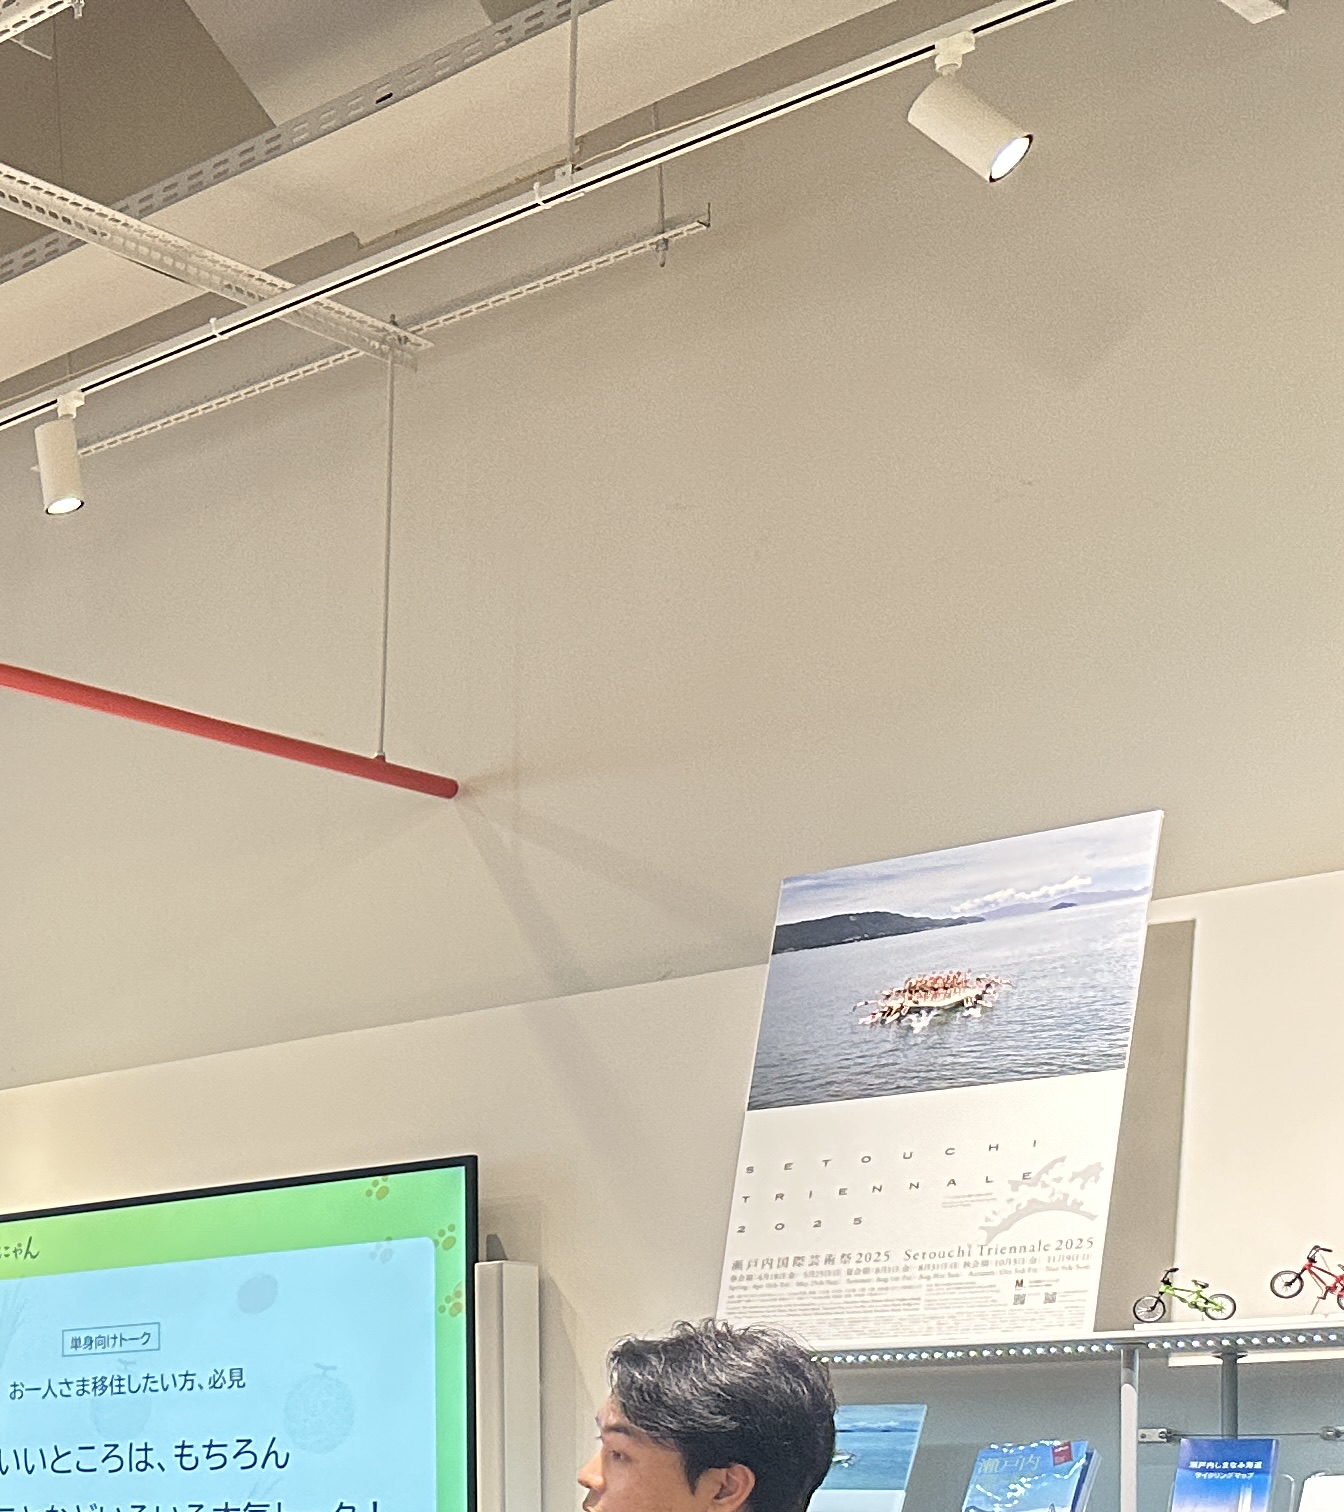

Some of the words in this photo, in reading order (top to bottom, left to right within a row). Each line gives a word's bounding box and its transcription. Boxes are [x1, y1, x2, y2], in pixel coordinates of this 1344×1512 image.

[745, 1139, 1038, 1174] SETOUCHI
[741, 1171, 1033, 1204] TRIENNALE
[736, 1216, 863, 1233] 2025
[903, 1243, 972, 1262] Setouchi
[977, 1239, 1050, 1257] Triennale
[1054, 1236, 1094, 1252] 2025
[69, 1330, 153, 1353] 単身向けトーク
[8, 1367, 246, 1401] お一人さま移住したい方、必見
